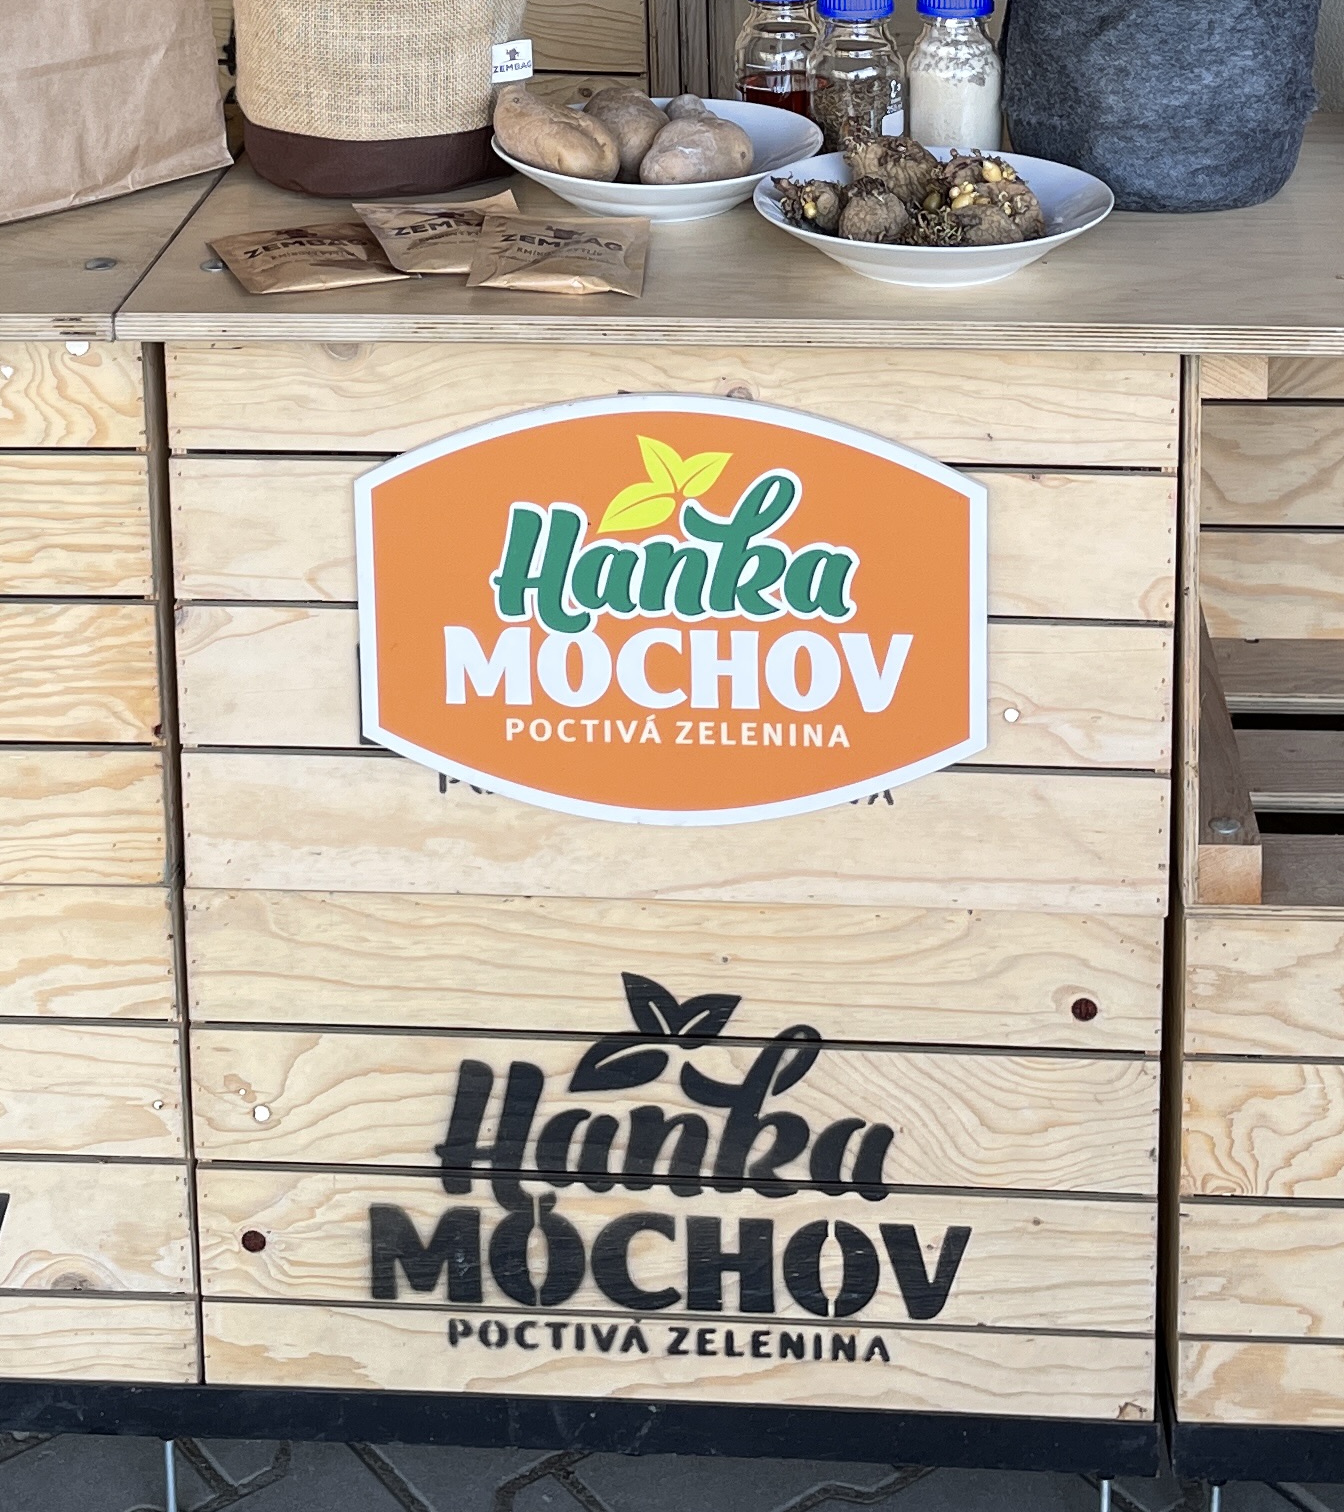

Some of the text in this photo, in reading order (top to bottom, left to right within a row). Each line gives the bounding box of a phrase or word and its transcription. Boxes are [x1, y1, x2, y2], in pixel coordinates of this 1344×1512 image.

[493, 59, 532, 73] ZEMBAG
[491, 469, 858, 635] Hanka
[444, 625, 914, 713] MOCHOV
[505, 714, 851, 749] POCTIVÁ ZELENINA
[435, 1024, 895, 1212] Hanka
[369, 1203, 972, 1320] MOCHOV
[668, 1326, 891, 1363] ZELENINA
